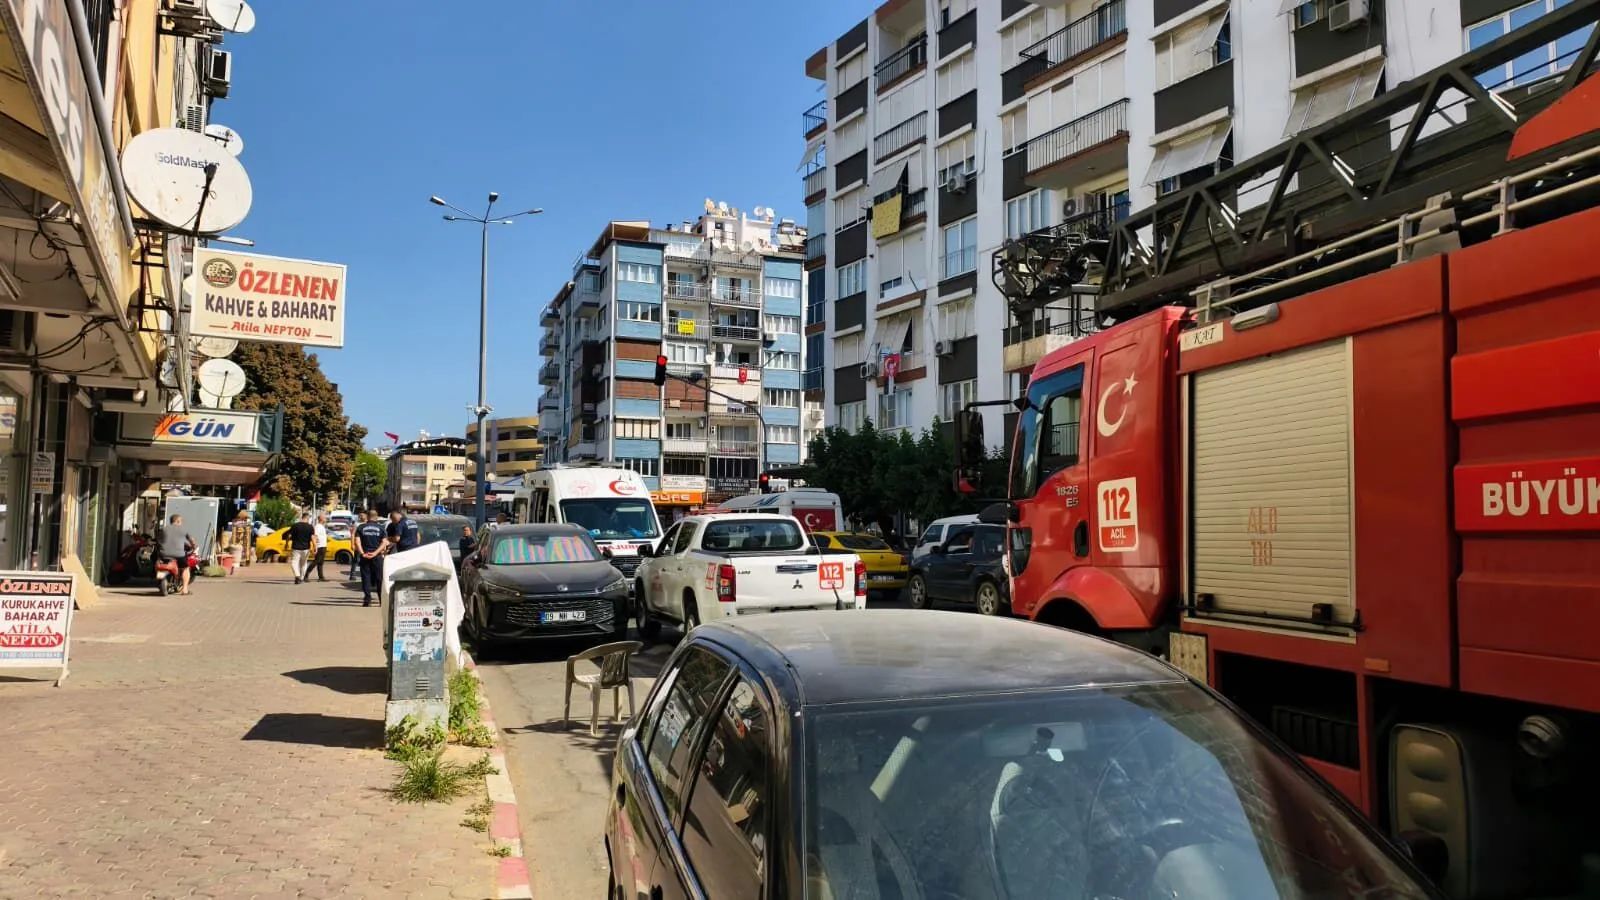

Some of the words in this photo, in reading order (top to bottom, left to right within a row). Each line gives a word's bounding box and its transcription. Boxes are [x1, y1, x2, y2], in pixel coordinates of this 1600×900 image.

[238, 262, 339, 301] ÖZLENEN
[205, 293, 254, 318] KAHVE
[257, 301, 268, 318] &
[271, 301, 337, 322] BAHARAT
[231, 321, 260, 333] Atila
[263, 324, 312, 337] NEPTON
[168, 418, 236, 438] GÜN
[1056, 485, 1079, 496] 1826
[1065, 498, 1079, 507] E5
[1103, 487, 1131, 521] 112
[1250, 541, 1272, 567] 110
[822, 565, 841, 579] 112
[0, 578, 71, 594] ÖZLENEN
[4, 611, 60, 621] BAHARAT
[8, 622, 53, 634] ATİLA
[0, 635, 60, 646] NEPTON
